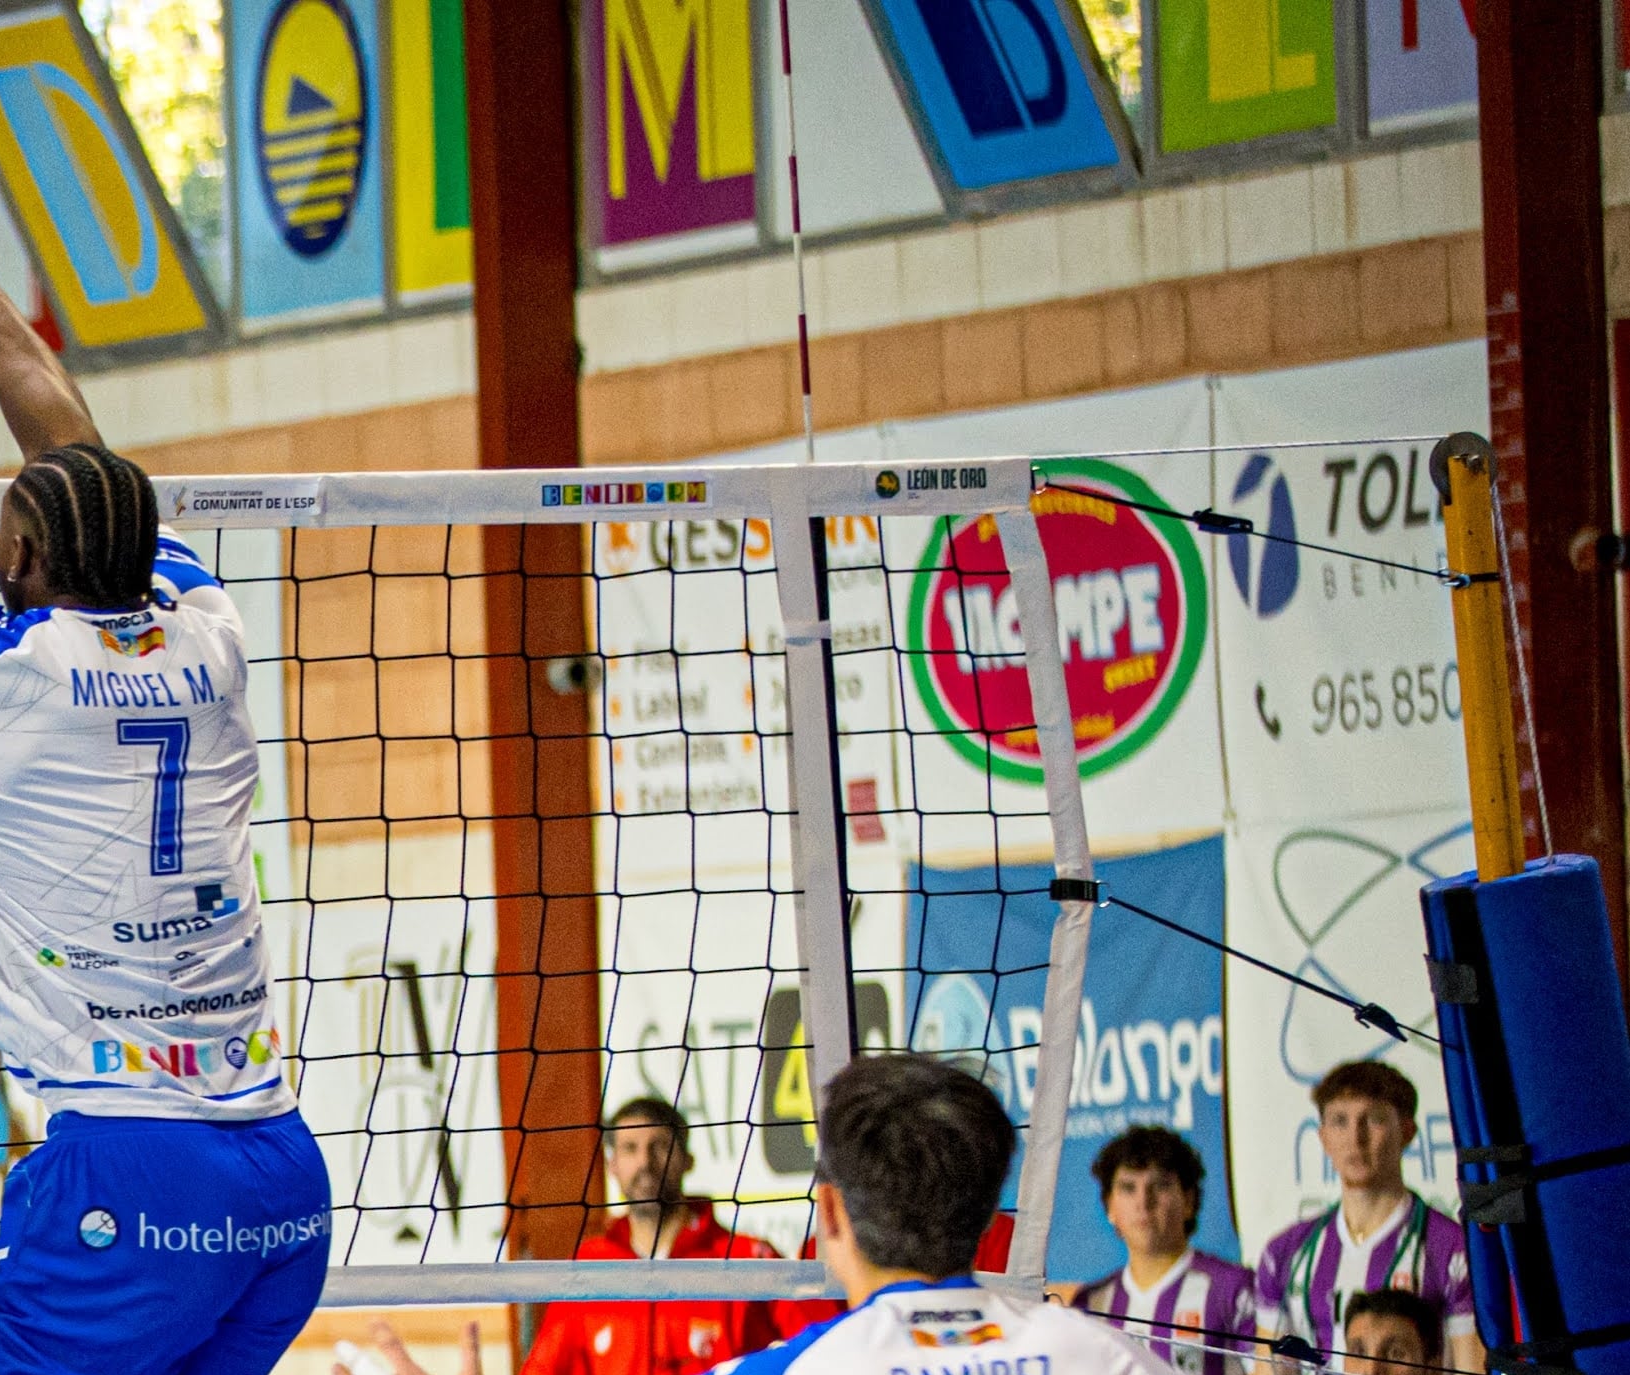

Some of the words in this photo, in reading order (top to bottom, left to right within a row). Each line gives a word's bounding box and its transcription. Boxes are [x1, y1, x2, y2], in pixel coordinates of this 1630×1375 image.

[542, 481, 708, 507] BENIDORM
[907, 468, 940, 490] LEÓN
[941, 471, 956, 489] DE
[959, 467, 987, 489] ORO
[1324, 451, 1444, 537] TOL
[193, 498, 263, 511] COMUNITAT
[265, 498, 280, 511] DE
[282, 496, 316, 510] L'ESP
[71, 667, 181, 708] MIGUEL
[184, 663, 226, 704] M.
[1312, 665, 1382, 738] 965
[117, 716, 191, 877] 7
[113, 916, 213, 944] suma
